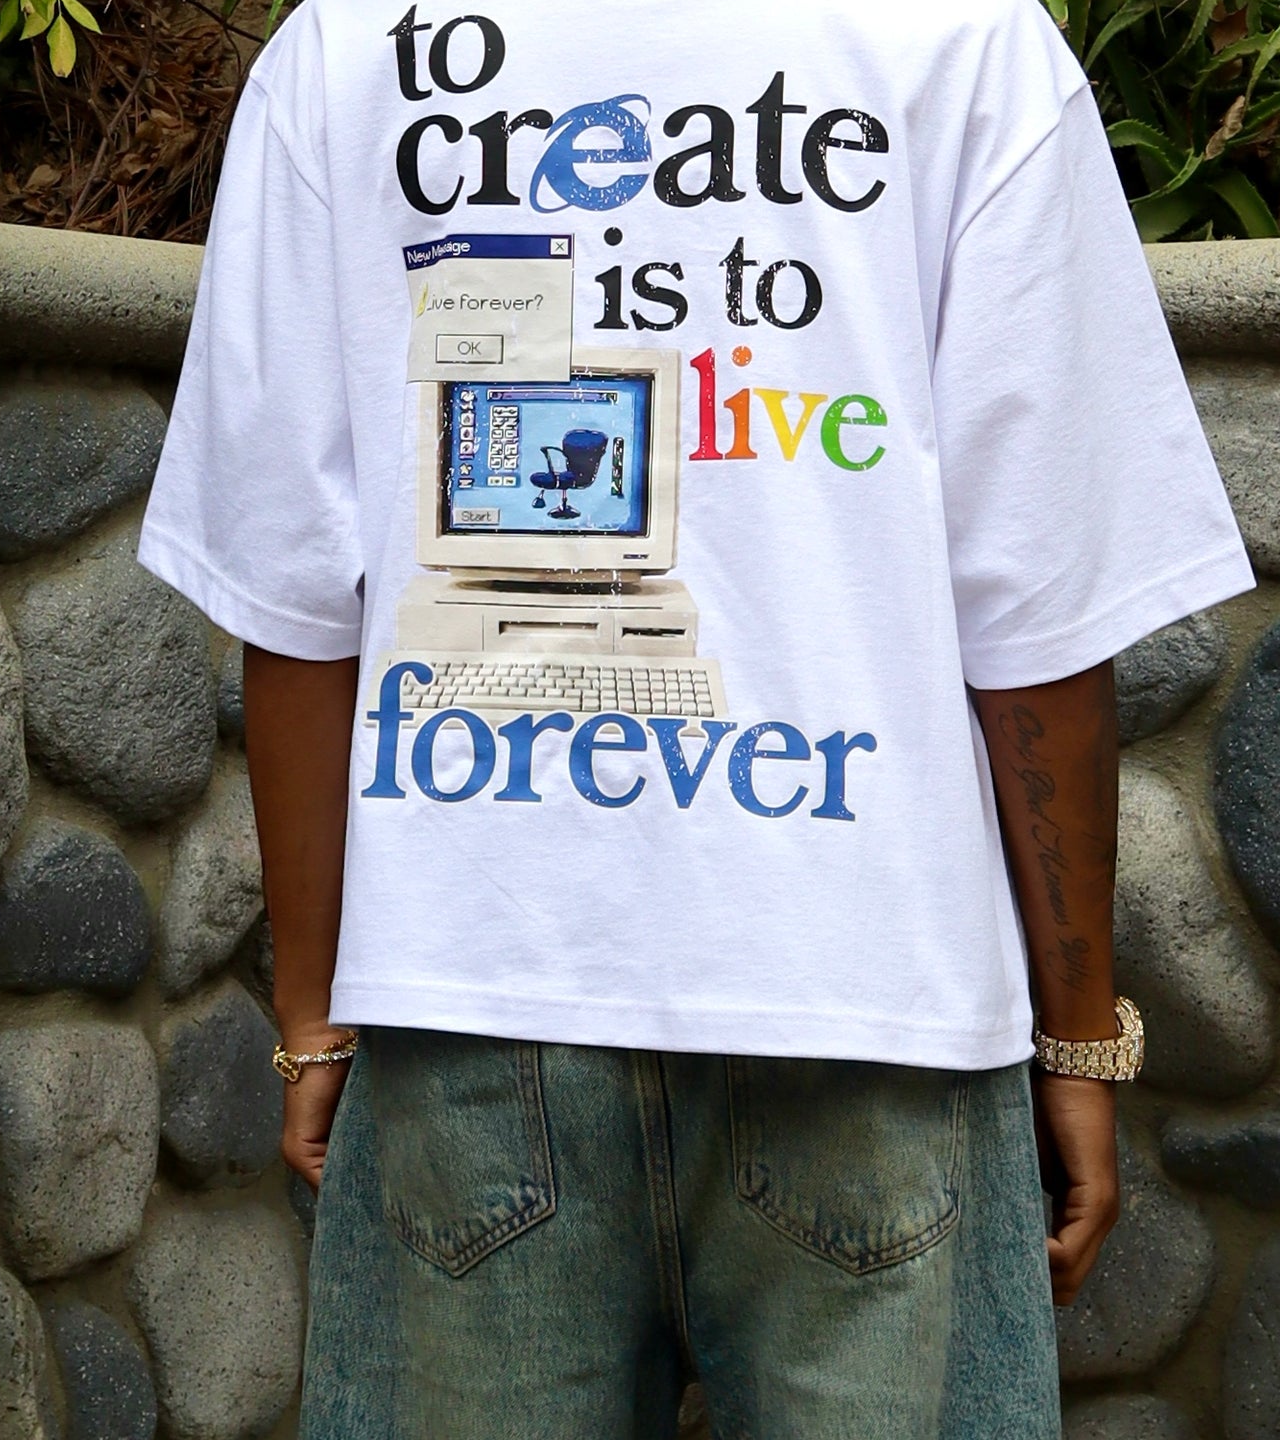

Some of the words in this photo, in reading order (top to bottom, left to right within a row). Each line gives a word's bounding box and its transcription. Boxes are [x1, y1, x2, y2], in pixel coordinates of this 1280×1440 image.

[387, 4, 505, 101] to
[396, 71, 889, 216] create
[406, 249, 431, 264] New
[426, 294, 455, 311] ive
[460, 293, 544, 311] forever?
[594, 227, 688, 331] is
[719, 236, 822, 331] to
[457, 341, 482, 356] OK
[689, 346, 888, 472] live
[460, 510, 493, 522] Start
[361, 661, 878, 822] forever
